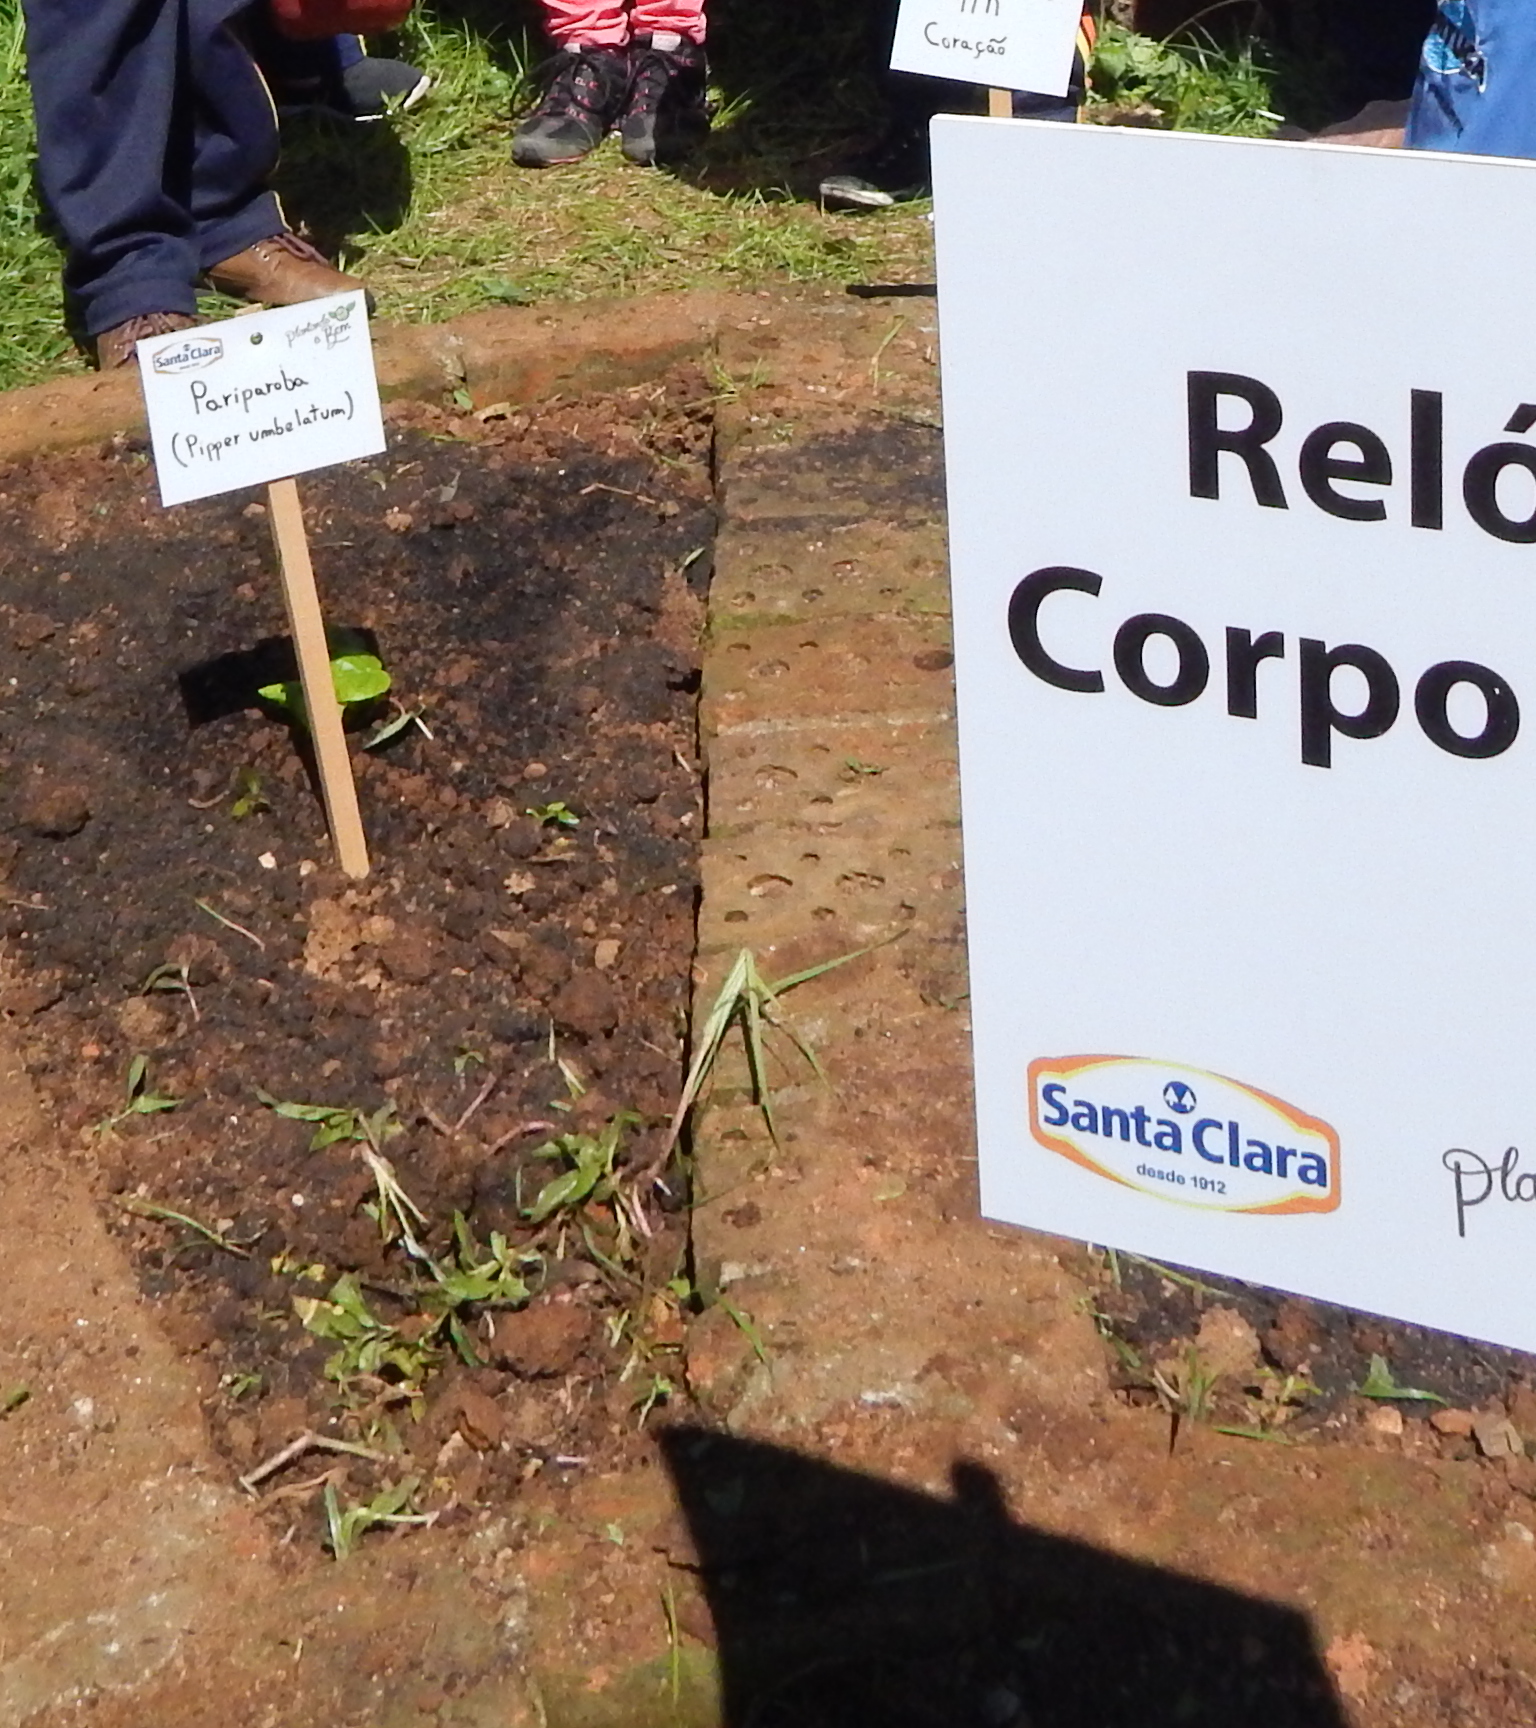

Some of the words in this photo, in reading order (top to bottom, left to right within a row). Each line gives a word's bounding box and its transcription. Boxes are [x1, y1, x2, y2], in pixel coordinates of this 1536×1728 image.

[924, 21, 1007, 59] Coração
[156, 354, 189, 368] Santa
[190, 346, 221, 360] Clara
[190, 368, 310, 415] Pariparoba
[171, 432, 240, 468] (Pipper
[248, 389, 354, 442] umbelatum)
[1007, 566, 1521, 769] Corpo
[1041, 1083, 1183, 1155] Santa
[1191, 1117, 1328, 1188] Clara
[1136, 1163, 1185, 1186] desde
[1191, 1175, 1227, 1195] 1912
